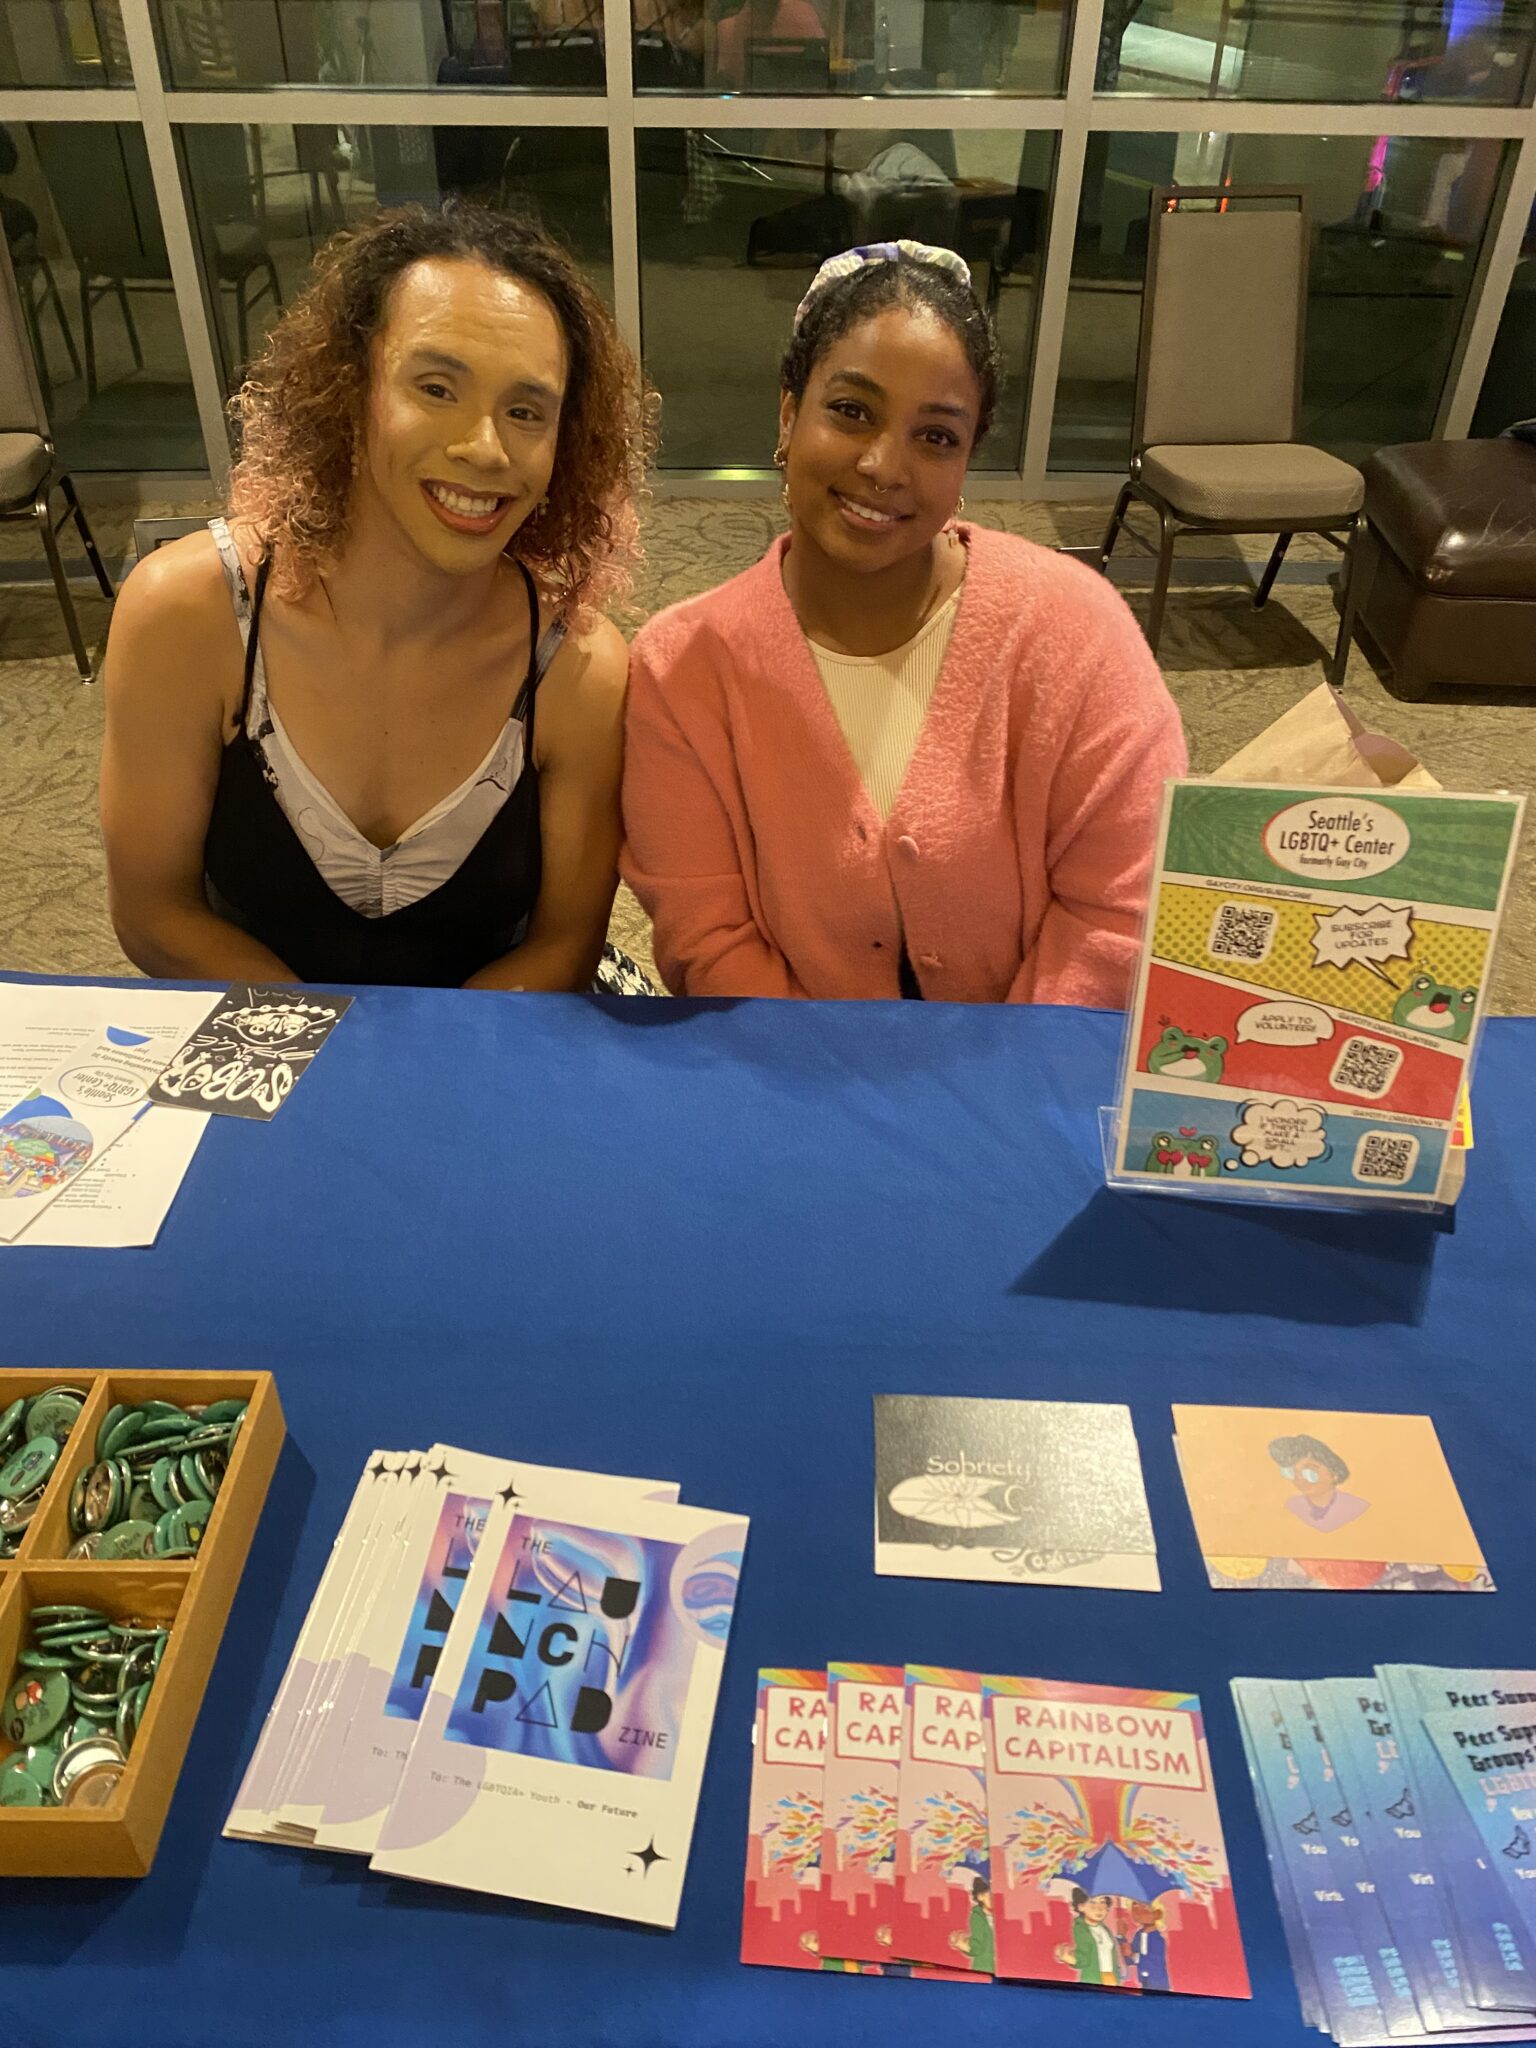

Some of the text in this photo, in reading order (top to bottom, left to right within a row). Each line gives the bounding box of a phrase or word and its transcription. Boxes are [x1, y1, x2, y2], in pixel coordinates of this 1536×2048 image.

[1308, 810, 1374, 832] Seattle's
[1280, 831, 1396, 856] LGBTQ+ Center
[1330, 919, 1393, 933] SUBSCRIBE
[1350, 930, 1373, 940] FOR
[1335, 937, 1389, 950] UPDATES
[1262, 1014, 1314, 1024] APPLY TO
[73, 1072, 139, 1097] LGBTQ+ Center
[77, 1085, 116, 1102] Seattle's
[927, 1450, 1031, 1484] Sobriety
[455, 1515, 487, 1532] THE
[522, 1537, 553, 1554] THE
[472, 1668, 613, 1734] PAD
[1445, 1691, 1489, 1708] Peer
[1015, 1706, 1172, 1740] RAINBOW
[619, 1726, 669, 1749] ZINE
[1453, 1731, 1497, 1749] Peer
[1005, 1736, 1190, 1775] CAPITALISM
[454, 1775, 472, 1787] The
[530, 1791, 561, 1804] Youth
[577, 1799, 596, 1811] Our
[602, 1804, 638, 1818] Future
